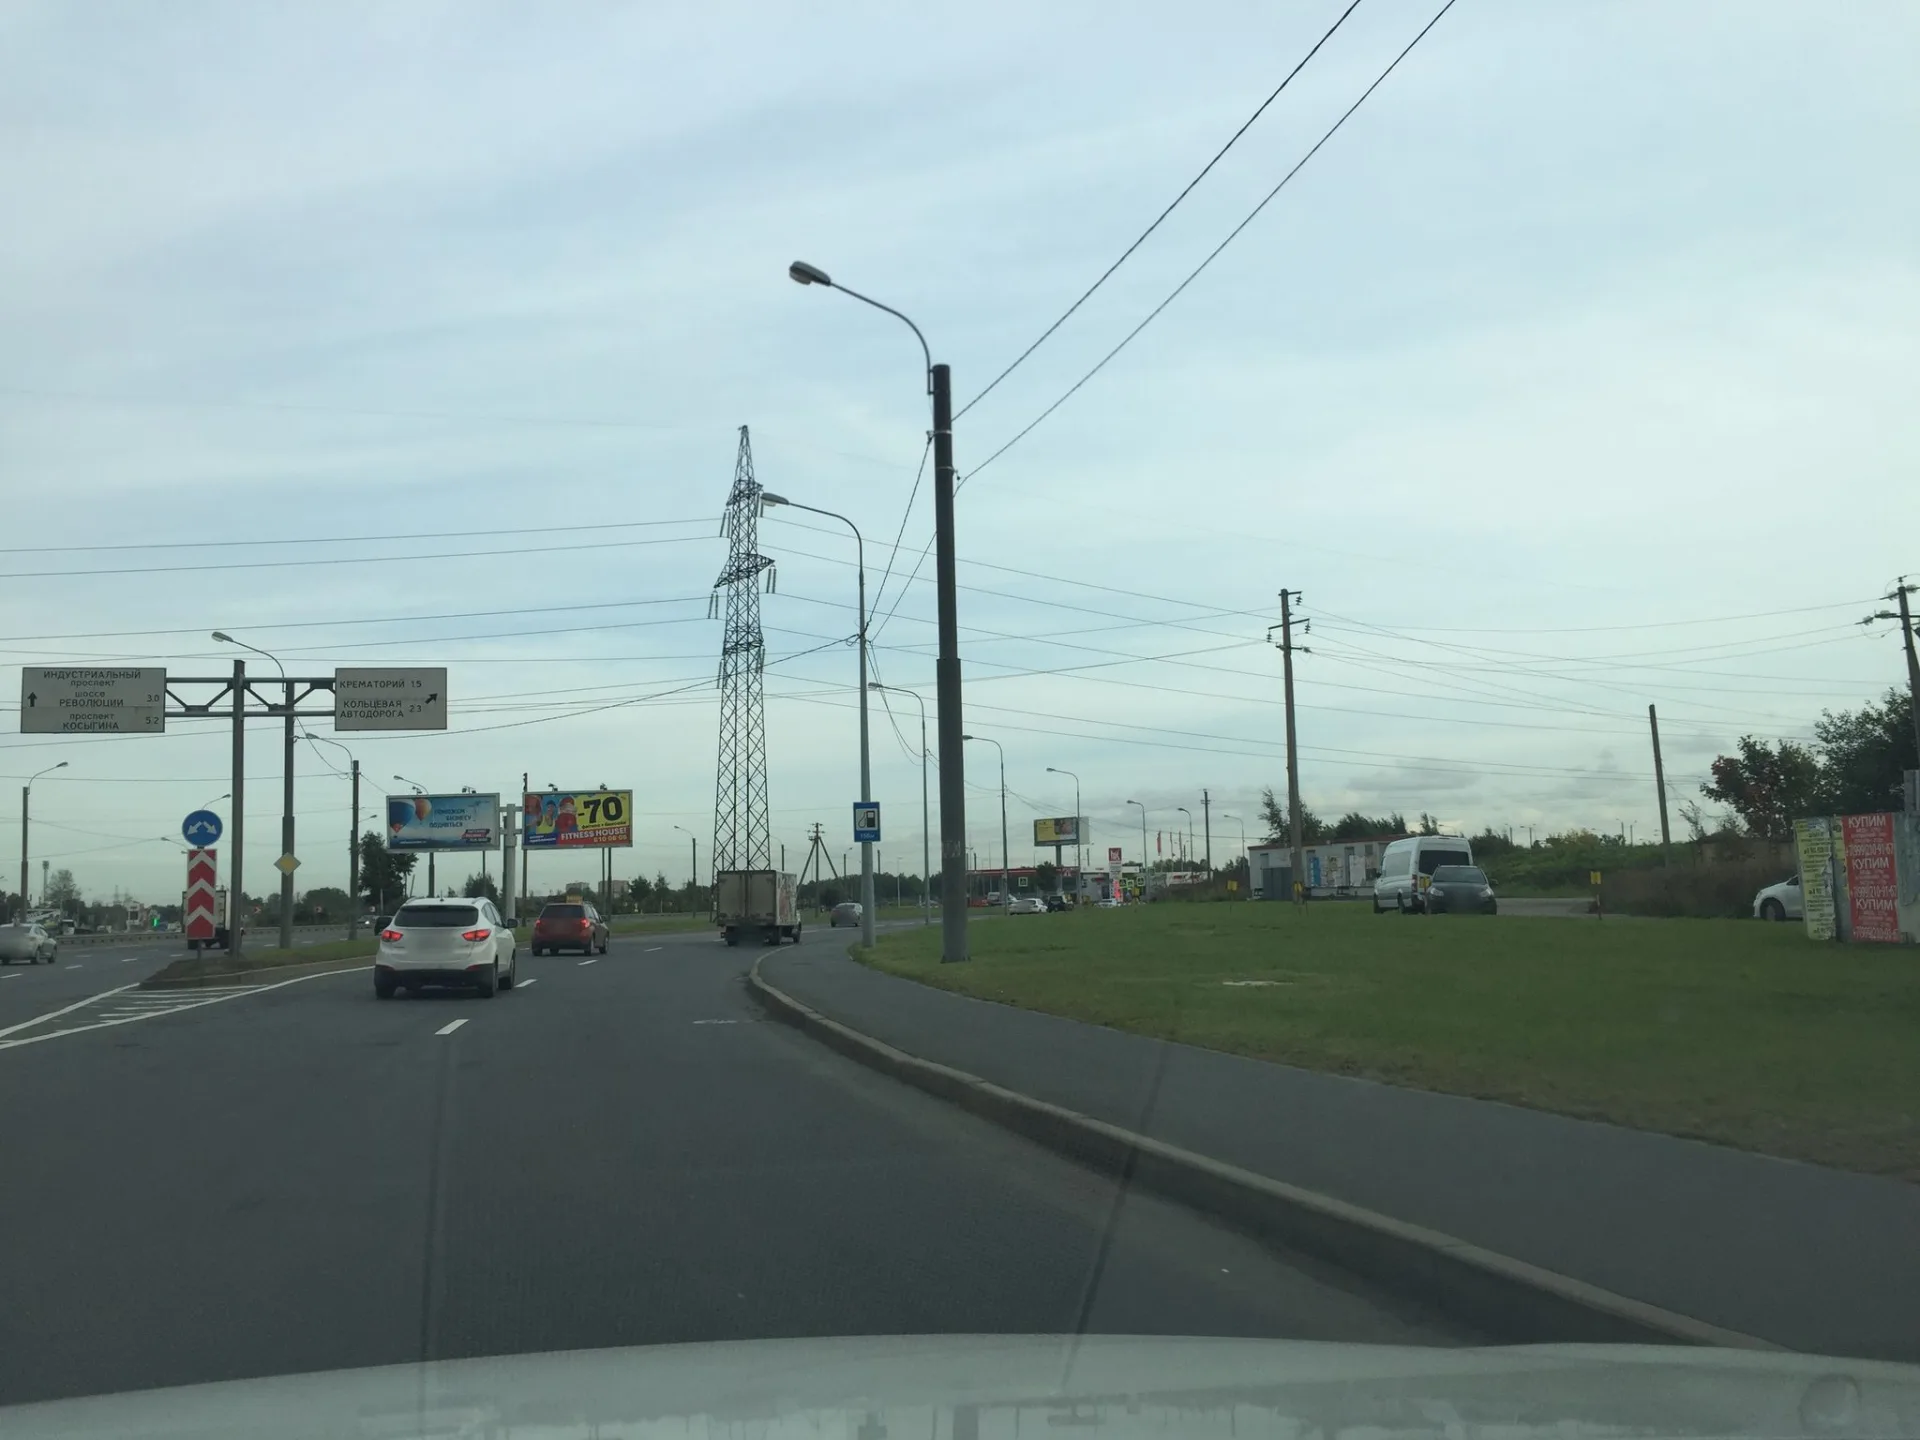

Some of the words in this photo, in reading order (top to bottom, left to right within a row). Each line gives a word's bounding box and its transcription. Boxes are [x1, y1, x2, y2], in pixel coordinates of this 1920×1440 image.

[43, 669, 141, 680] ИНДУСТРИАЛЬНЫЙ
[340, 679, 405, 688] КРЕМАТОРИЙ
[59, 699, 124, 708] РЕВОЛЮЦИИ
[343, 700, 402, 709] КОЛЬЦЕВАЯ
[340, 709, 404, 719] АВТОДОРОГА
[62, 721, 119, 730] КОСЫГИНА
[1848, 815, 1886, 828] КУПИМ
[560, 831, 595, 841] FITNESS
[1852, 857, 1890, 870] КУПИМ
[1856, 898, 1893, 911] КУПИМ
